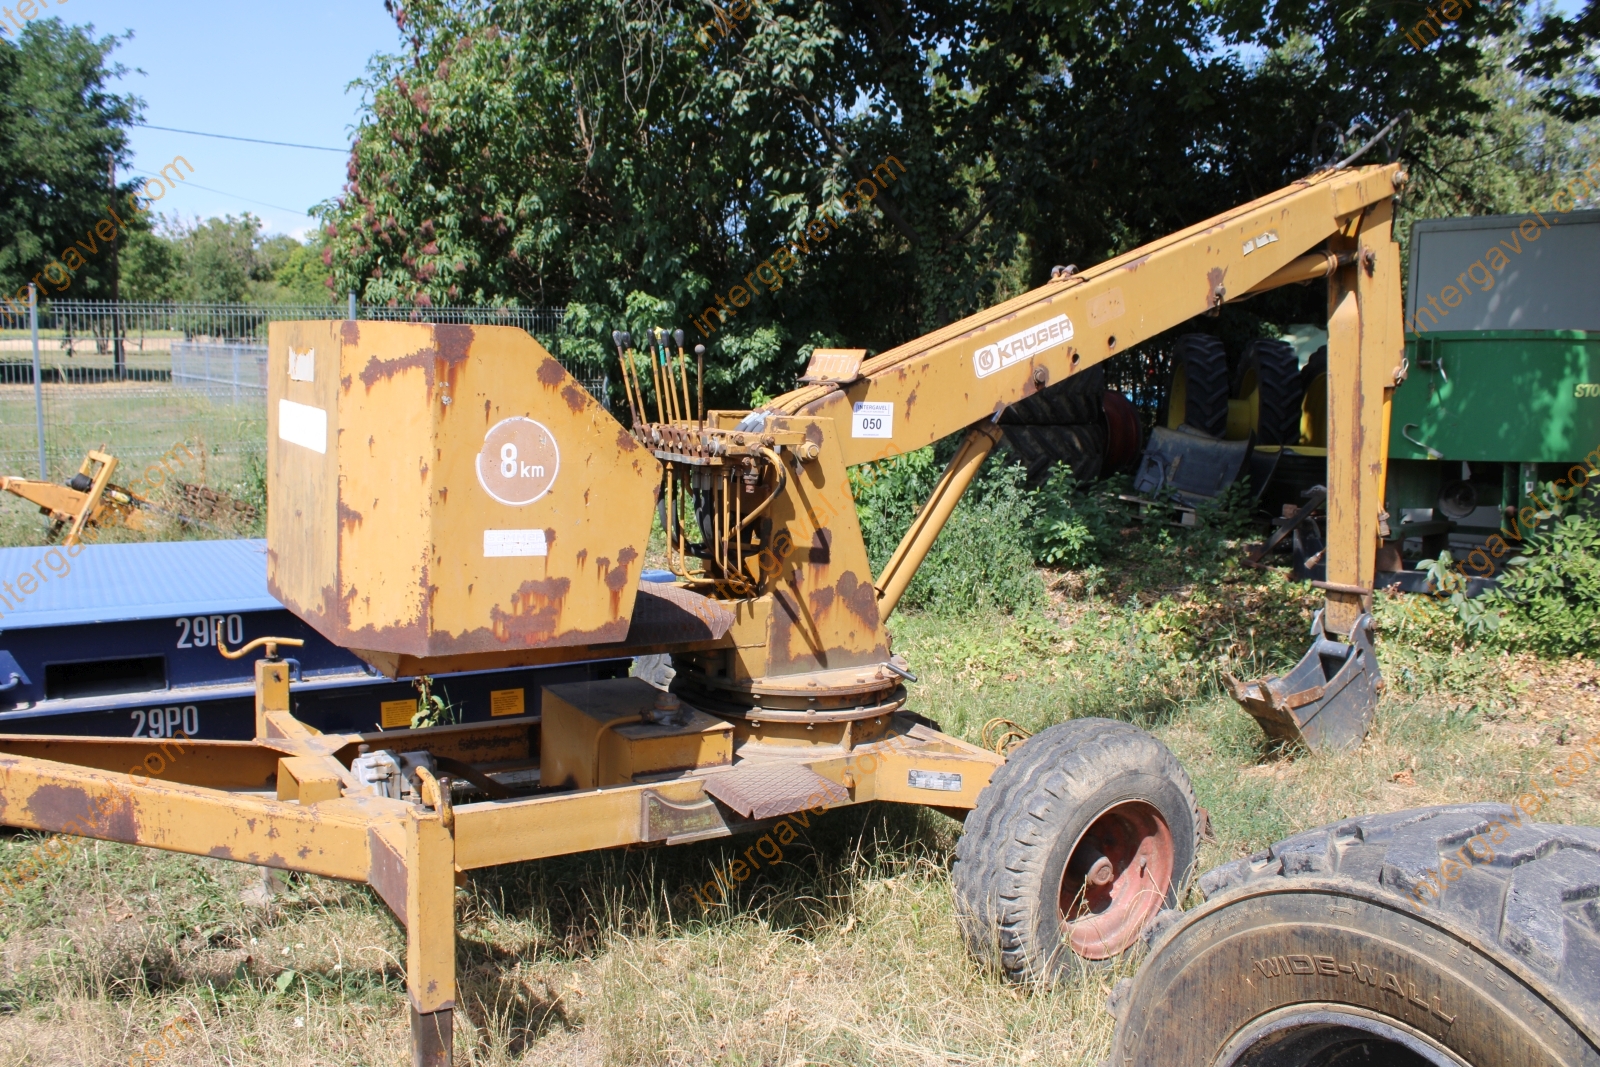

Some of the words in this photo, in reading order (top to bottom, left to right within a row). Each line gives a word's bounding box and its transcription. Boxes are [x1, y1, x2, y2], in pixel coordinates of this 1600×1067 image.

[998, 318, 1072, 359] KRÜGER
[862, 418, 882, 430] 050
[500, 442, 518, 478] 8
[520, 460, 545, 478] km
[1254, 953, 1456, 1024] WIDE-WALL
[1398, 920, 1510, 992] PROTECTED
[1520, 999, 1571, 1047] WALL
